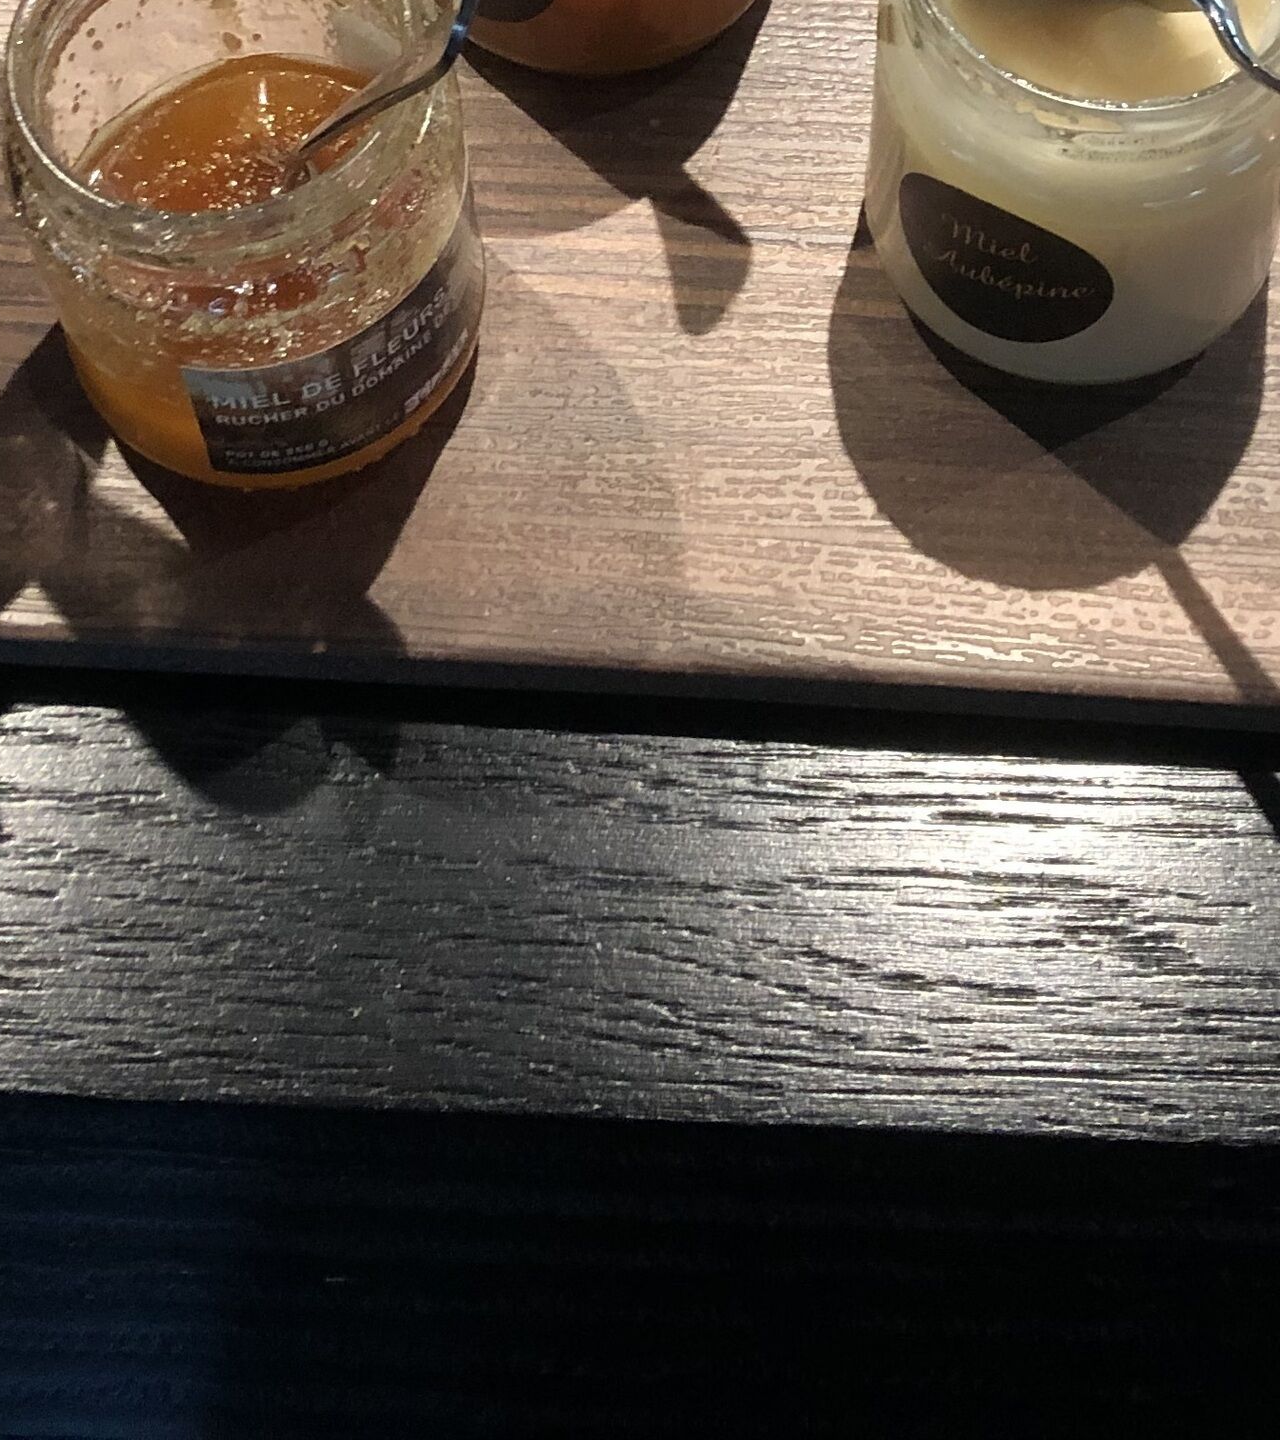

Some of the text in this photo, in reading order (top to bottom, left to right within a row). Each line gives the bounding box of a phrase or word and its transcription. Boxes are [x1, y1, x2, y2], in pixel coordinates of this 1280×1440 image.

[940, 212, 1038, 263] Miel
[210, 286, 445, 410] MIEL DE FLEURS
[215, 405, 309, 426] RUCHER
[314, 391, 346, 413] DU
[351, 329, 432, 398] DOMAINE
